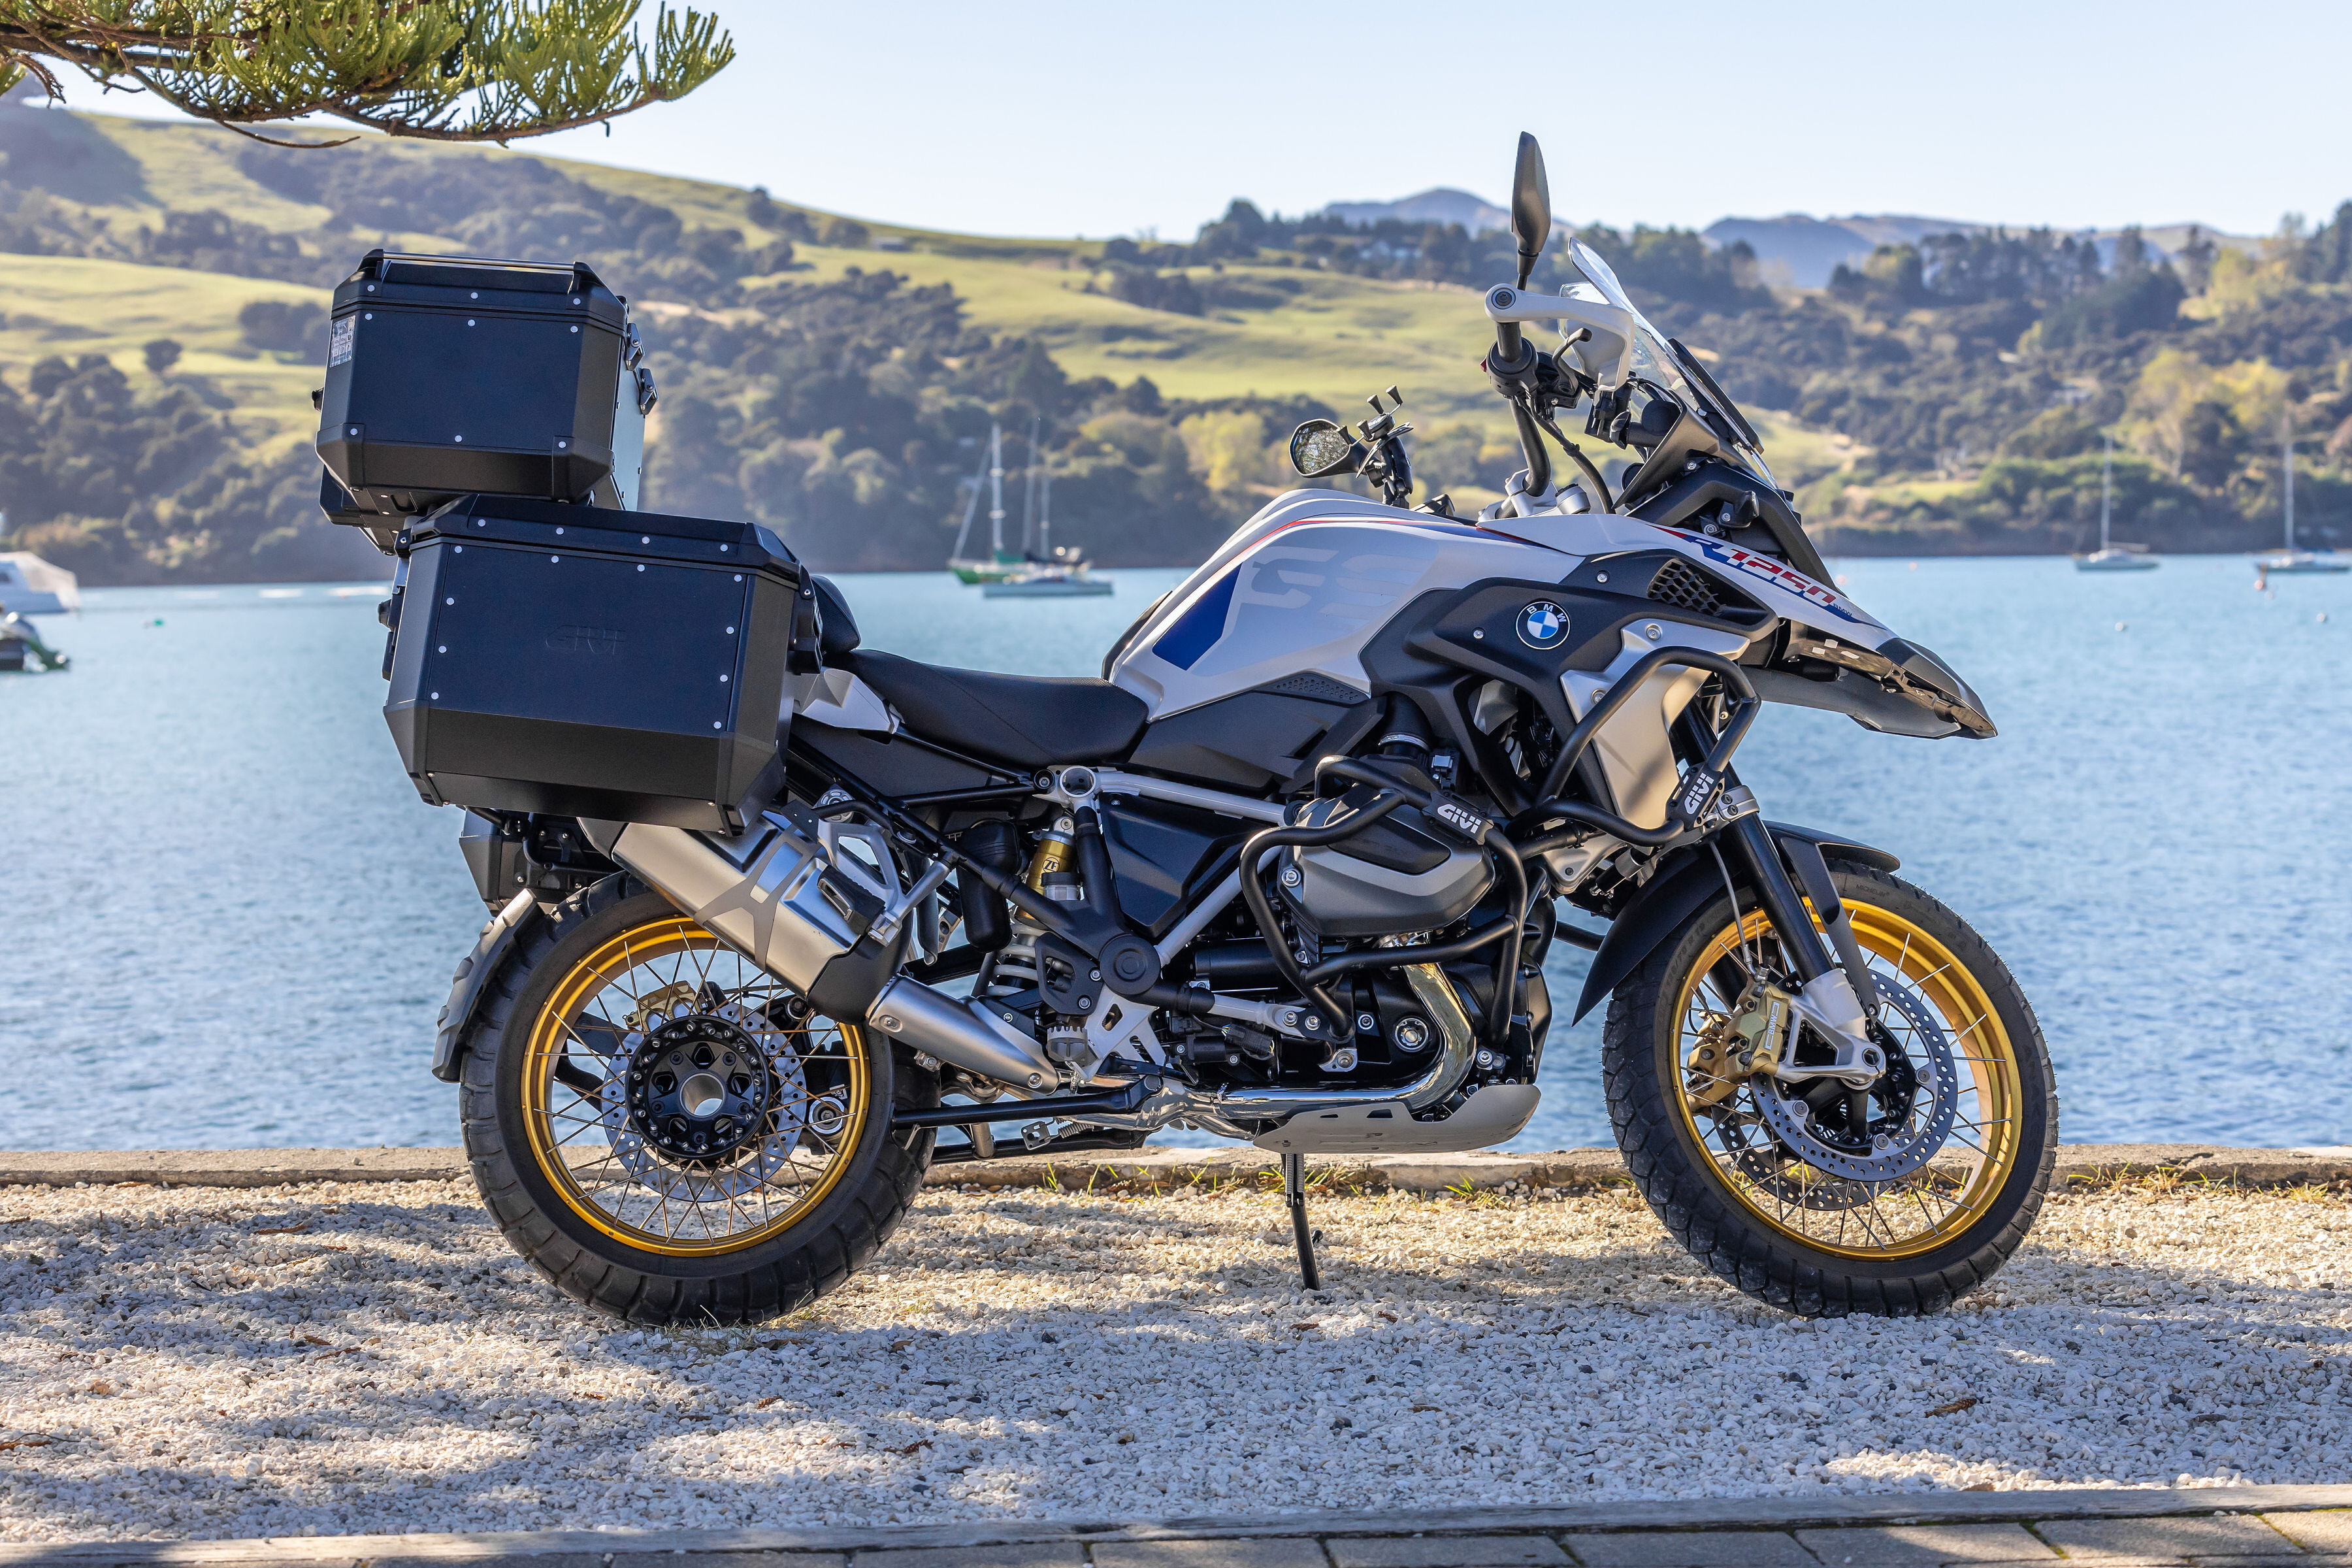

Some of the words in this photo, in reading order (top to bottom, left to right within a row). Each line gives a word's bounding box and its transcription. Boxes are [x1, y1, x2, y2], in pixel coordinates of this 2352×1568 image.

[1682, 535, 1731, 564] R
[1726, 548, 1837, 607] 1250
[1526, 604, 1567, 623] BMW
[1833, 602, 1852, 617] BMW
[544, 623, 627, 655] GIVI
[1684, 772, 1714, 814] GIVI
[1437, 804, 1482, 834] GIVI
[1043, 858, 1060, 872] ZF
[1768, 1015, 1778, 1035] BMW
